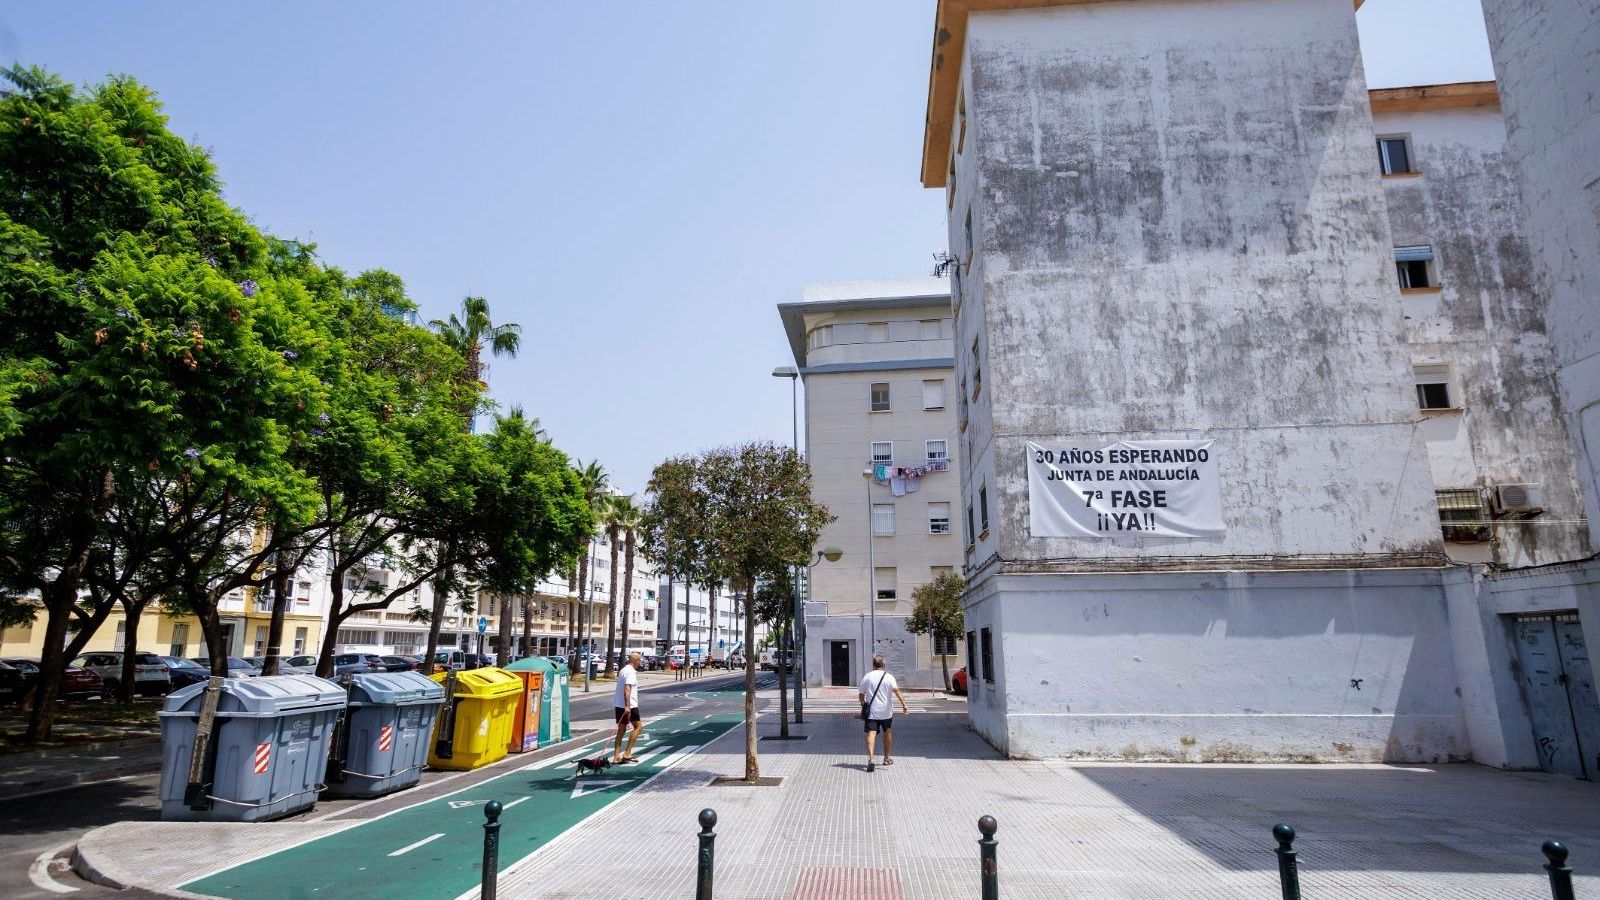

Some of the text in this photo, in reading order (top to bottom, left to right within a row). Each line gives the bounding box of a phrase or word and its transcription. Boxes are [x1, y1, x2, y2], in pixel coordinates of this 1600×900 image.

[1035, 447, 1209, 464] 30 AÑOS ESPERANDO
[1047, 467, 1200, 482] JUNTA DE ANDALUCÍA
[1082, 490, 1167, 508] 7ª FASE
